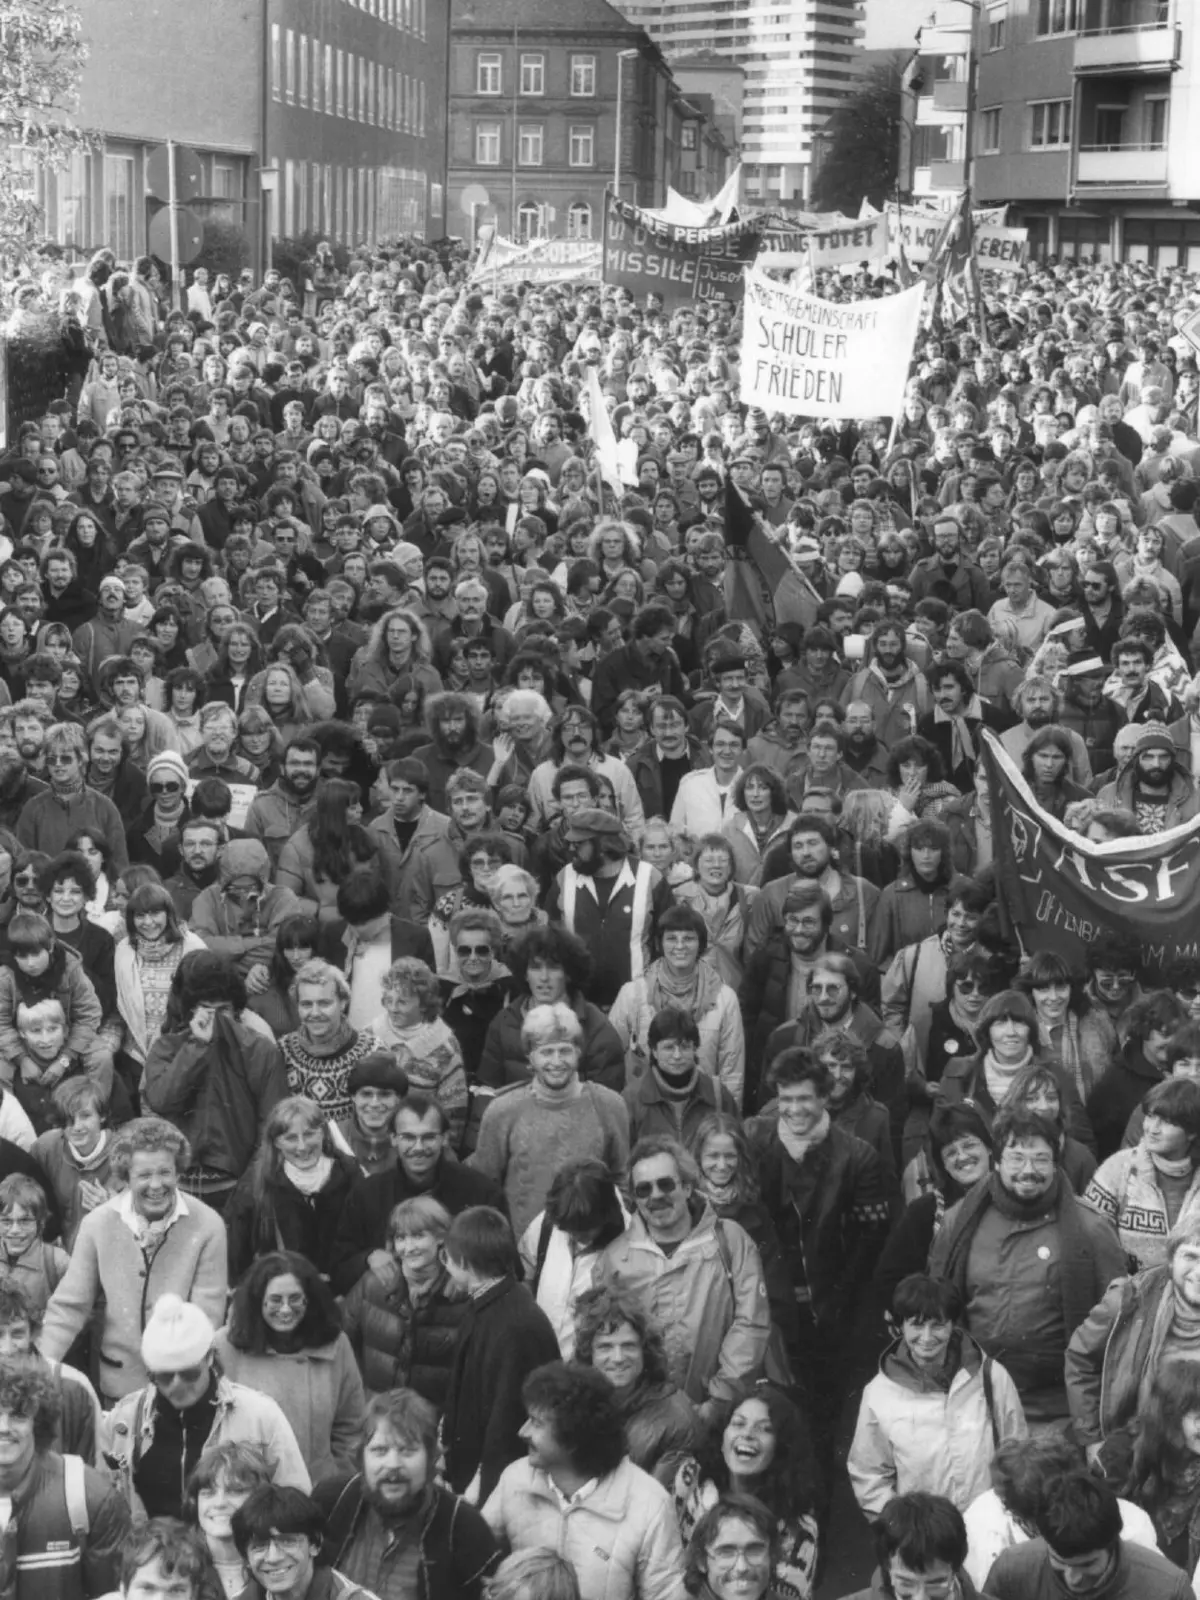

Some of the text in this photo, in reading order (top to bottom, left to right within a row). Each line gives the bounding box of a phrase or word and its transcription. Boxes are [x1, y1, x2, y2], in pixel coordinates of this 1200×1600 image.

[606, 247, 695, 284] MISSILE
[978, 237, 1024, 262] EBEN
[754, 360, 843, 403] FRIEDEN
